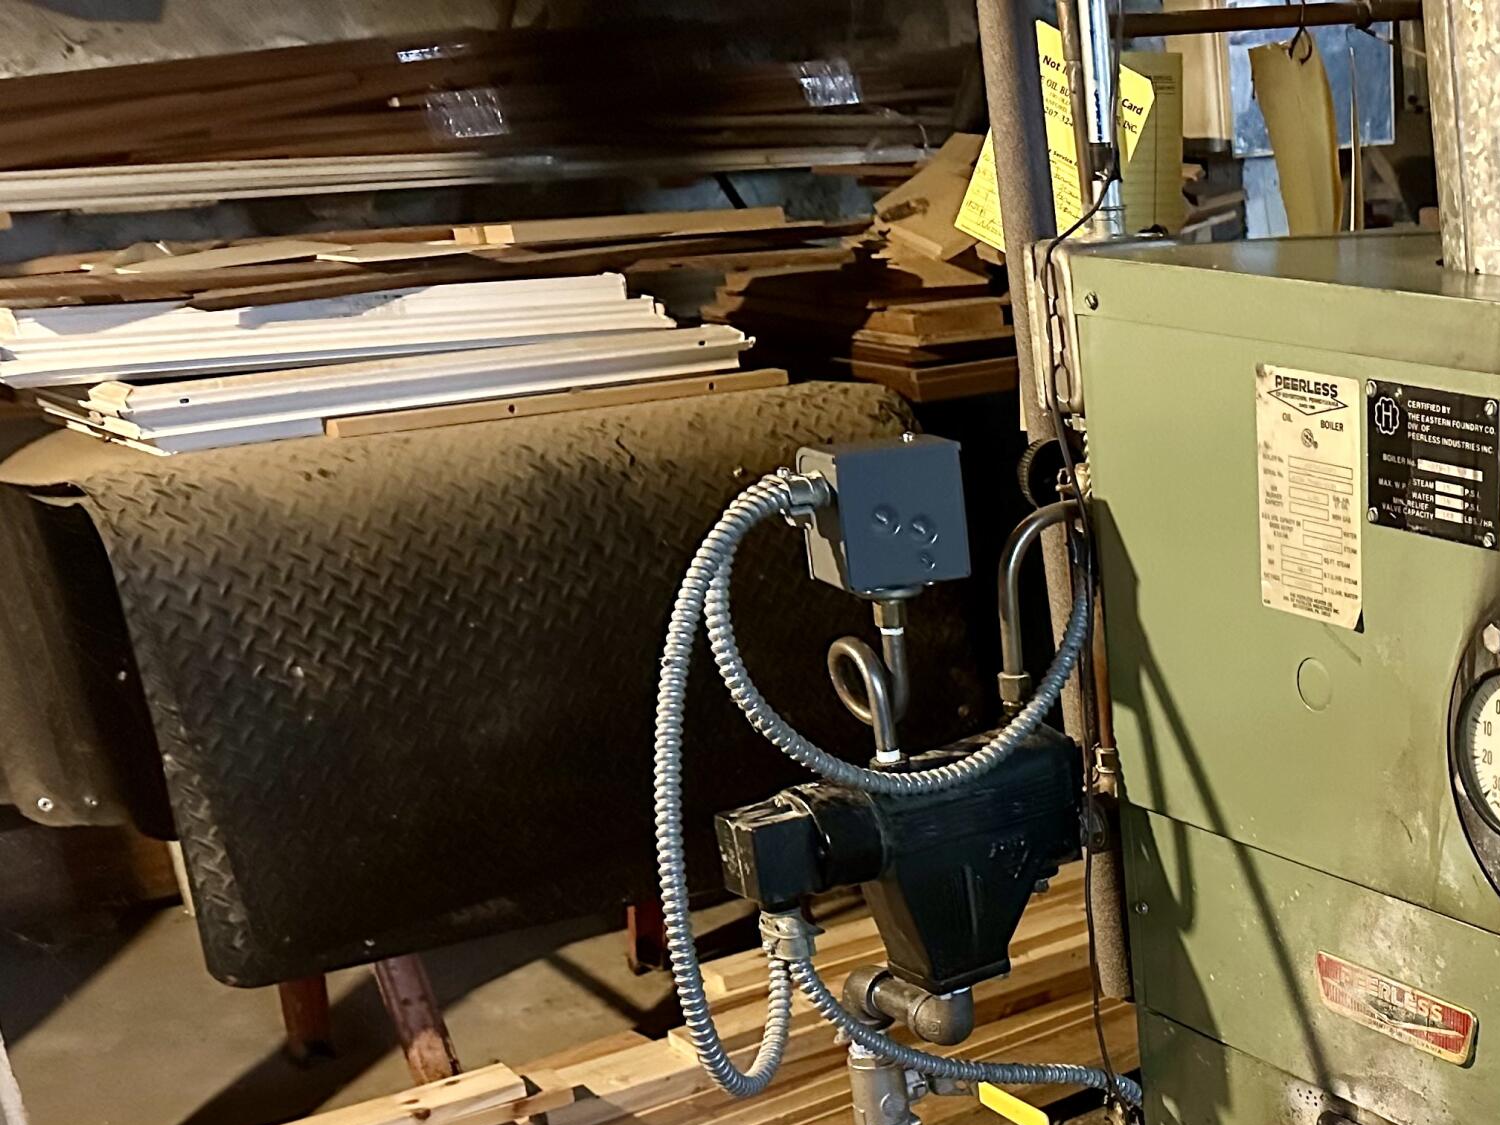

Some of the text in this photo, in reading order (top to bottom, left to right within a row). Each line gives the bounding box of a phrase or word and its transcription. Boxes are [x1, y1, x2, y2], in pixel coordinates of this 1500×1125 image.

[1042, 55, 1143, 116] Not Card
[1046, 79, 1058, 91] OIL
[1053, 150, 1073, 164] Service
[1275, 375, 1338, 398] PEERLESS
[1407, 400, 1451, 414] CERTIFIED BY
[1282, 412, 1344, 432] OIL BOILER
[1407, 412, 1496, 435] THE EASTERN FOUNDRY CO.
[1421, 424, 1430, 433] OF
[1407, 431, 1441, 445] PEERLESS
[1441, 438, 1481, 452] INDUSTRIES
[1382, 453, 1406, 465] BOILER
[1412, 478, 1435, 489] STEAM
[1406, 499, 1429, 510] RELIEF
[1411, 491, 1435, 503] WATER
[1382, 502, 1402, 514] VALVE
[1402, 507, 1434, 520] CAPACITY
[1495, 699, 1500, 715] 0
[1483, 720, 1492, 736] 10
[1482, 749, 1493, 766] 20
[1340, 966, 1443, 1024] PEERLESS
